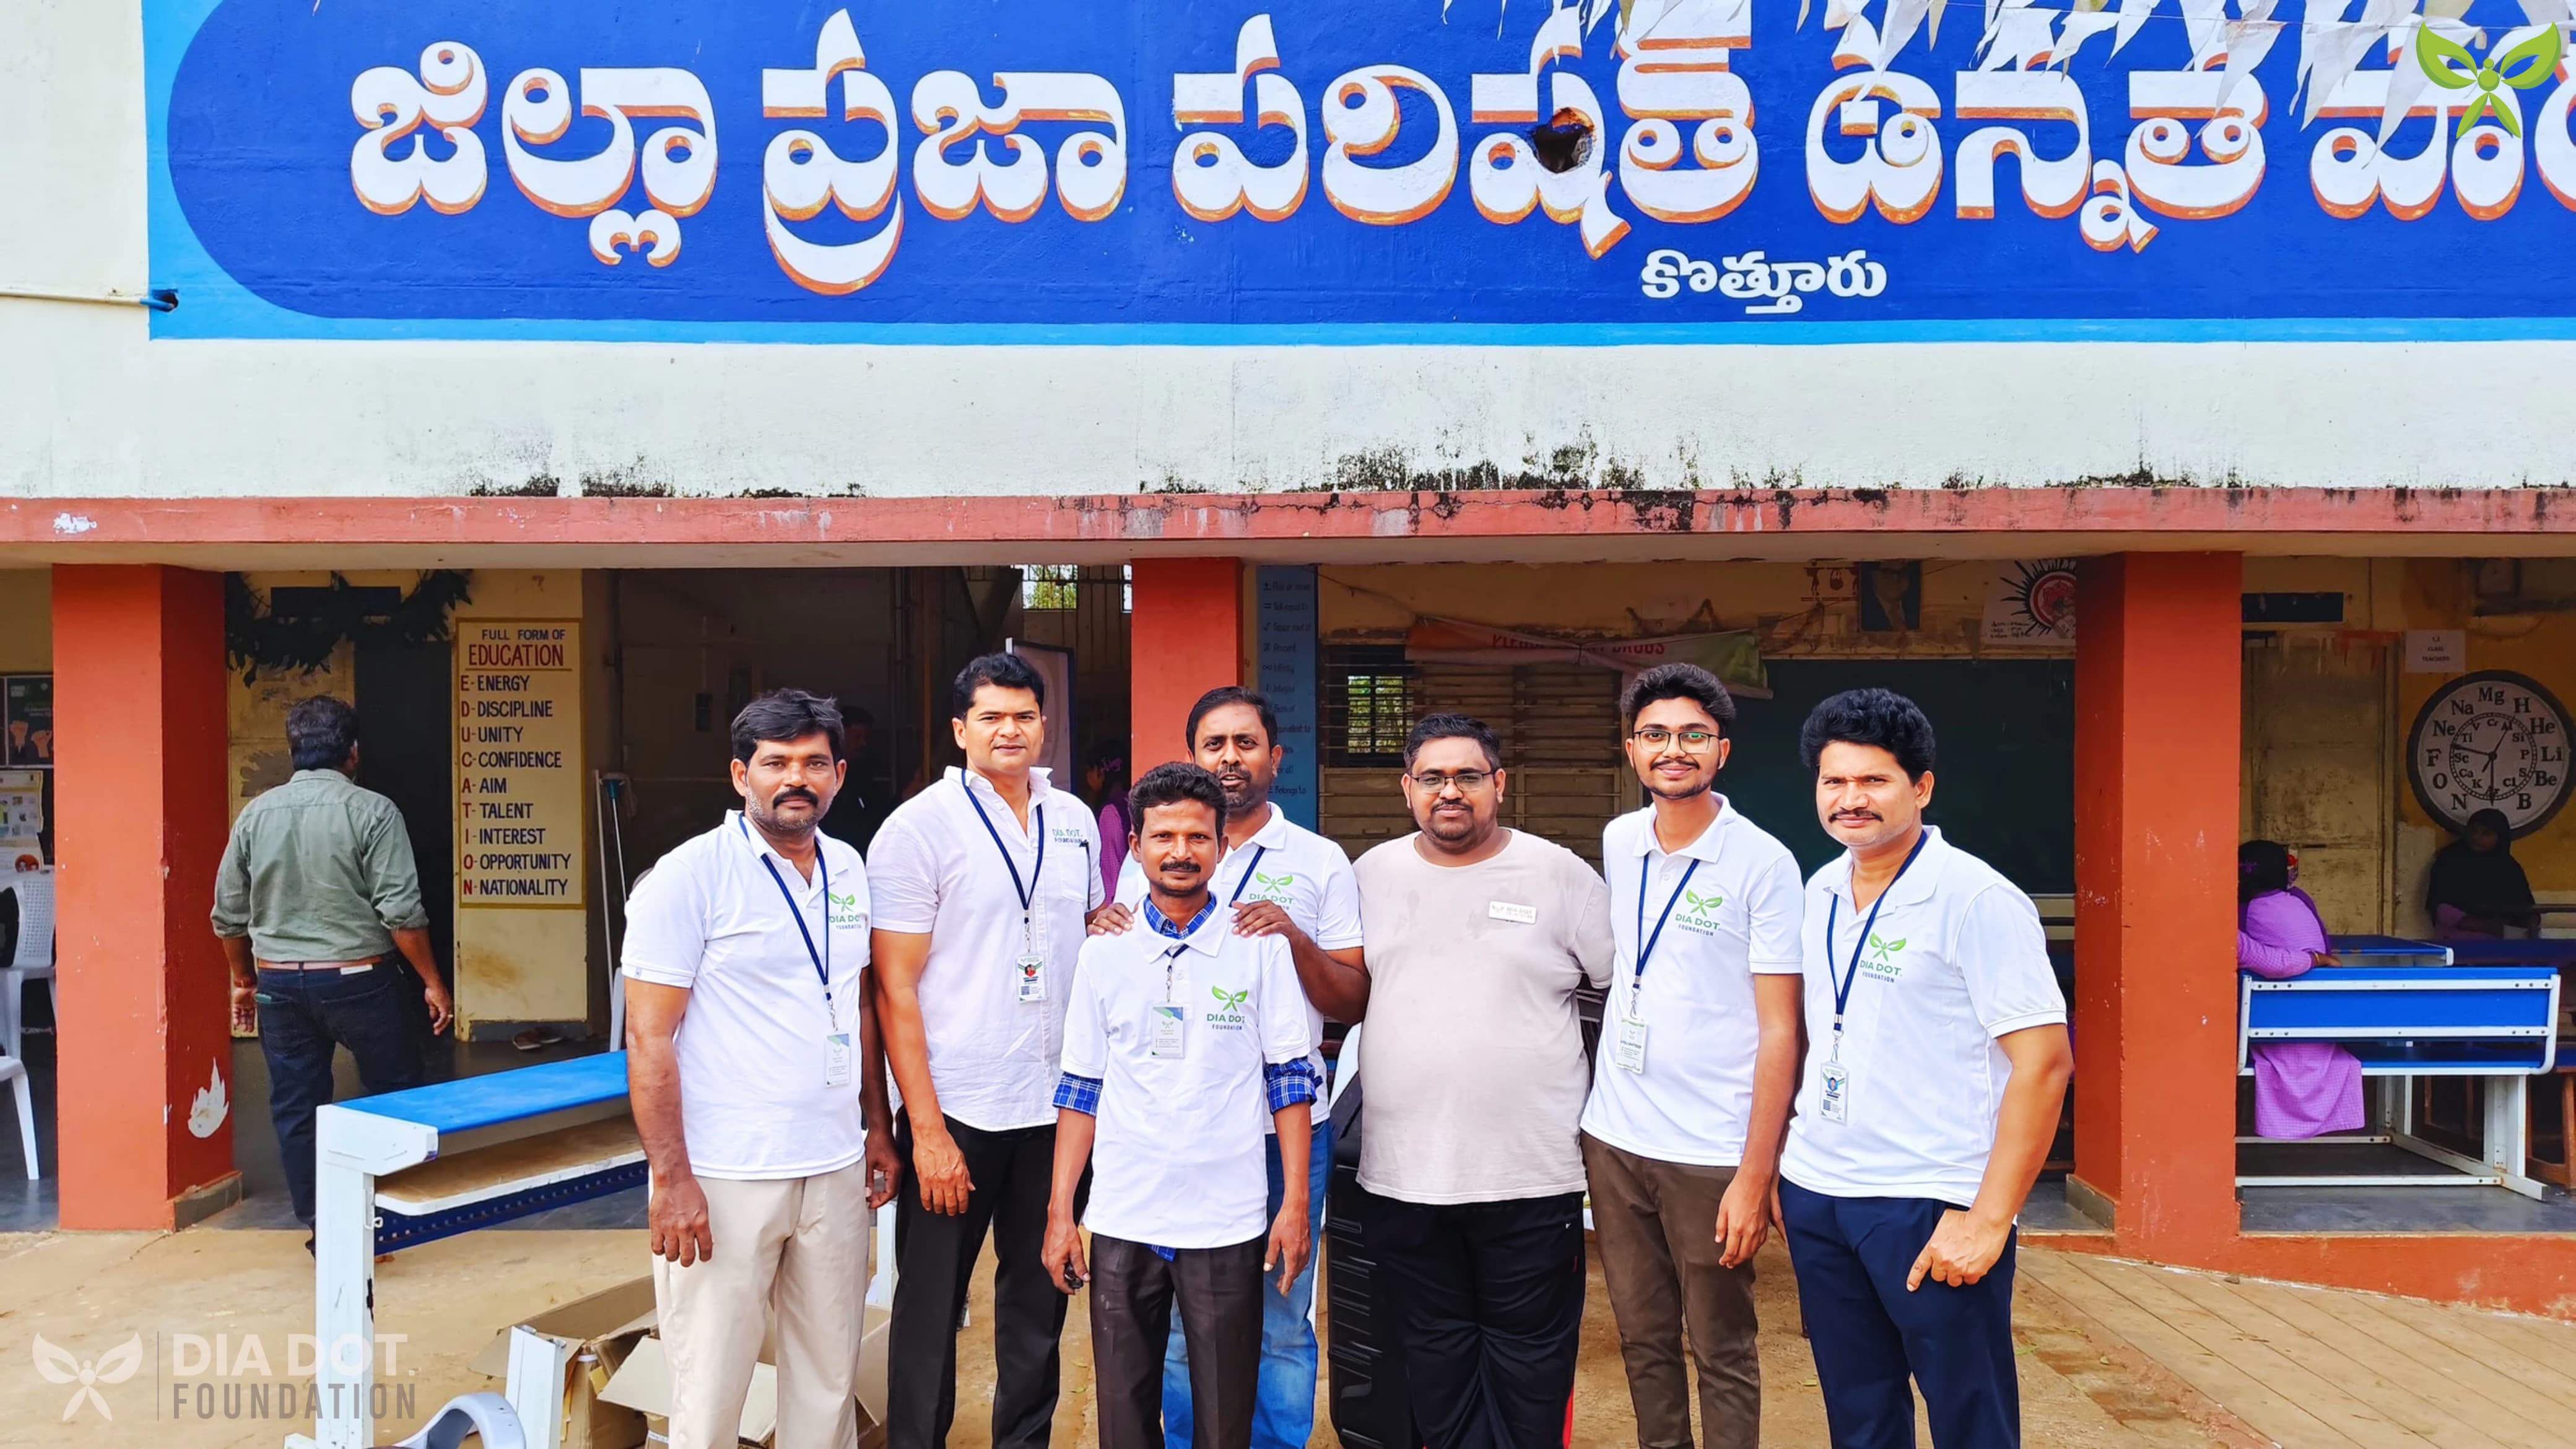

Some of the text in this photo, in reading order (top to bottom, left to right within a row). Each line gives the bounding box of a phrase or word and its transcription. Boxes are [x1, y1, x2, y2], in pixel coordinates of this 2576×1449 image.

[350, 40, 720, 268] జిల్లా
[762, 7, 1128, 296] ప్రజా
[1641, 248, 1888, 315] కొత్తూరు
[482, 629, 565, 640] FULL FORM OF
[468, 645, 564, 666] EDUCATION
[477, 675, 530, 691] ENERGY
[2478, 687, 2505, 705] Mg
[477, 700, 553, 717] DISCIPLINE
[2451, 700, 2474, 715] Na
[2513, 697, 2531, 713] H
[2432, 720, 2456, 736] Ne
[2530, 717, 2556, 734] He
[478, 726, 523, 742] UNITY
[2512, 733, 2525, 742] Si
[478, 752, 562, 768] CONFIDENCE
[2426, 748, 2442, 767] F
[2454, 753, 2469, 764] Sc
[2520, 749, 2530, 759] P
[2541, 746, 2563, 762] Li
[2459, 768, 2474, 778] Ca
[2519, 767, 2527, 777] S
[2533, 770, 2557, 786] Be
[479, 778, 507, 793] AIM
[2433, 773, 2448, 790] O
[2472, 779, 2482, 789] K
[2451, 793, 2468, 810] N
[2517, 793, 2532, 810] B
[479, 803, 534, 819] TALENT
[479, 829, 546, 844] INTEREST
[480, 854, 572, 870] OPPORTUNITY
[480, 879, 568, 895] NATIONALITY
[1675, 913, 1692, 923] DIA
[1678, 923, 1713, 936] FOUNDATION
[1860, 960, 1874, 970] DIA
[1207, 1014, 1226, 1022] DIA
